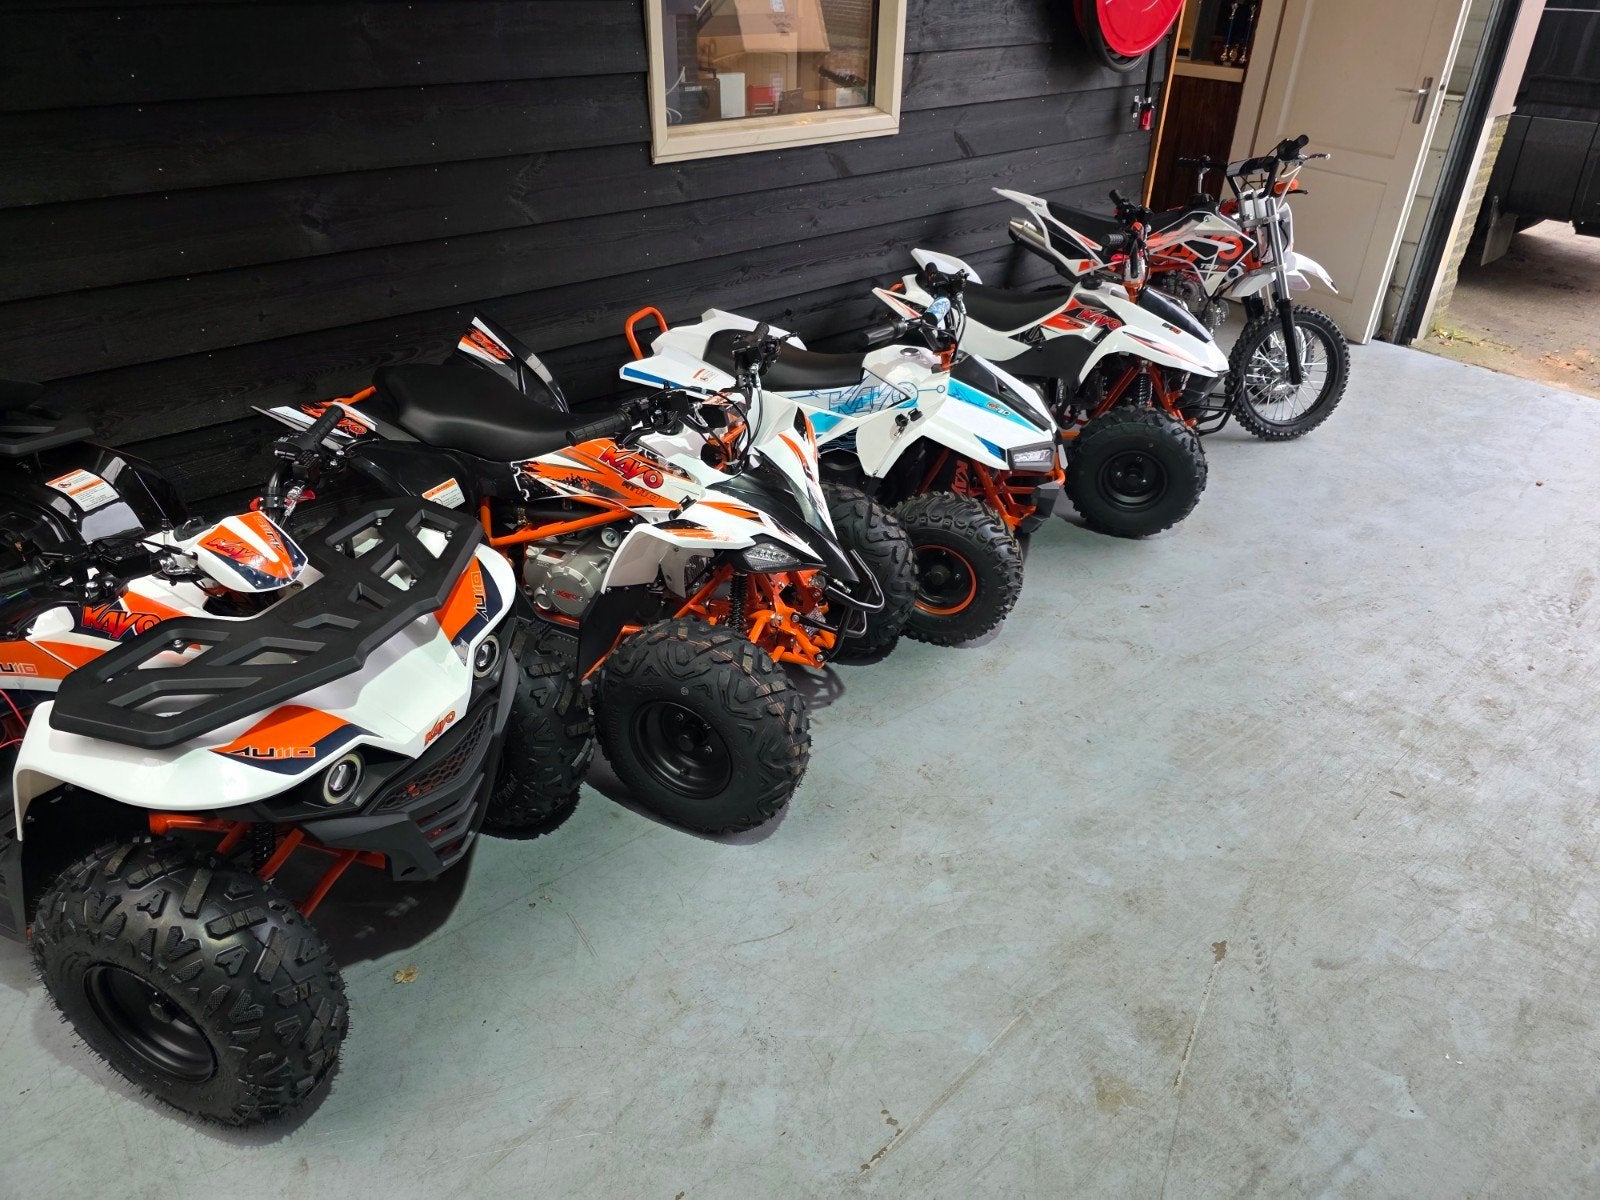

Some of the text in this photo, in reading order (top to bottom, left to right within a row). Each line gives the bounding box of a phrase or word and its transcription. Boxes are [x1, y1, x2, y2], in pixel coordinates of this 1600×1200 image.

[1077, 308, 1122, 331] KAYO
[598, 445, 664, 489] KAYO
[470, 570, 490, 623] AU110
[82, 602, 162, 640] KAYO
[0, 662, 38, 676] U110
[424, 710, 456, 747] KAYO
[227, 744, 316, 761] AU110
